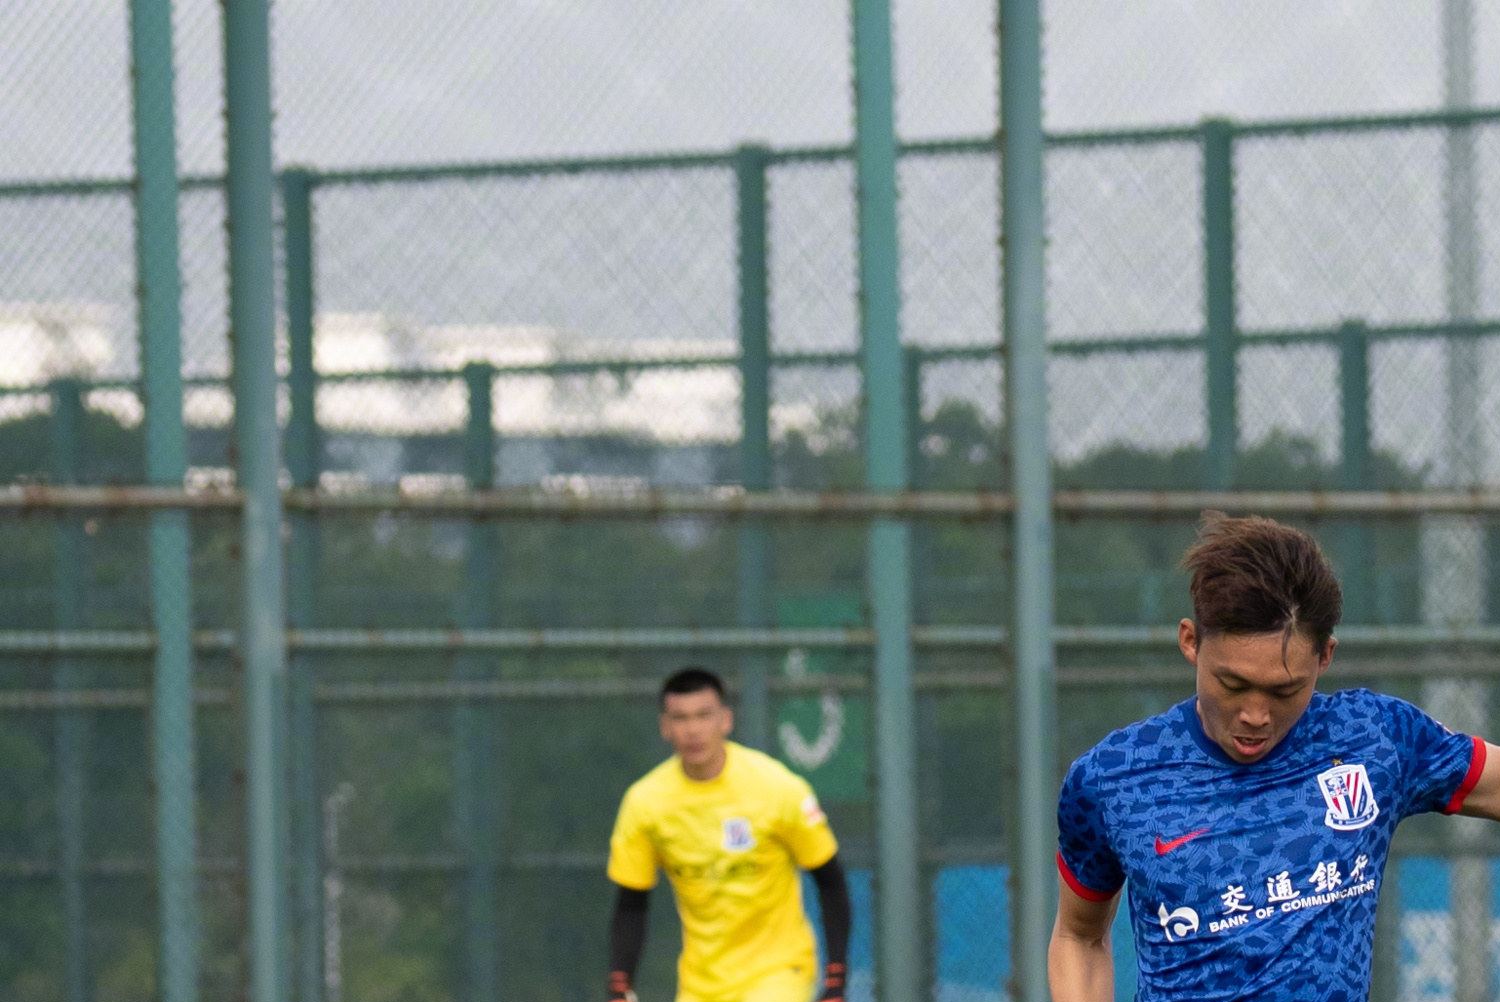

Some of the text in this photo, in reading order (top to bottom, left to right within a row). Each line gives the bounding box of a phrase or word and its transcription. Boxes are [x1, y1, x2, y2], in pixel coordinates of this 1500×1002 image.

[1208, 878, 1376, 933] BANK OF COMMUNICATIONS
[1221, 854, 1369, 915] 交通銀行
